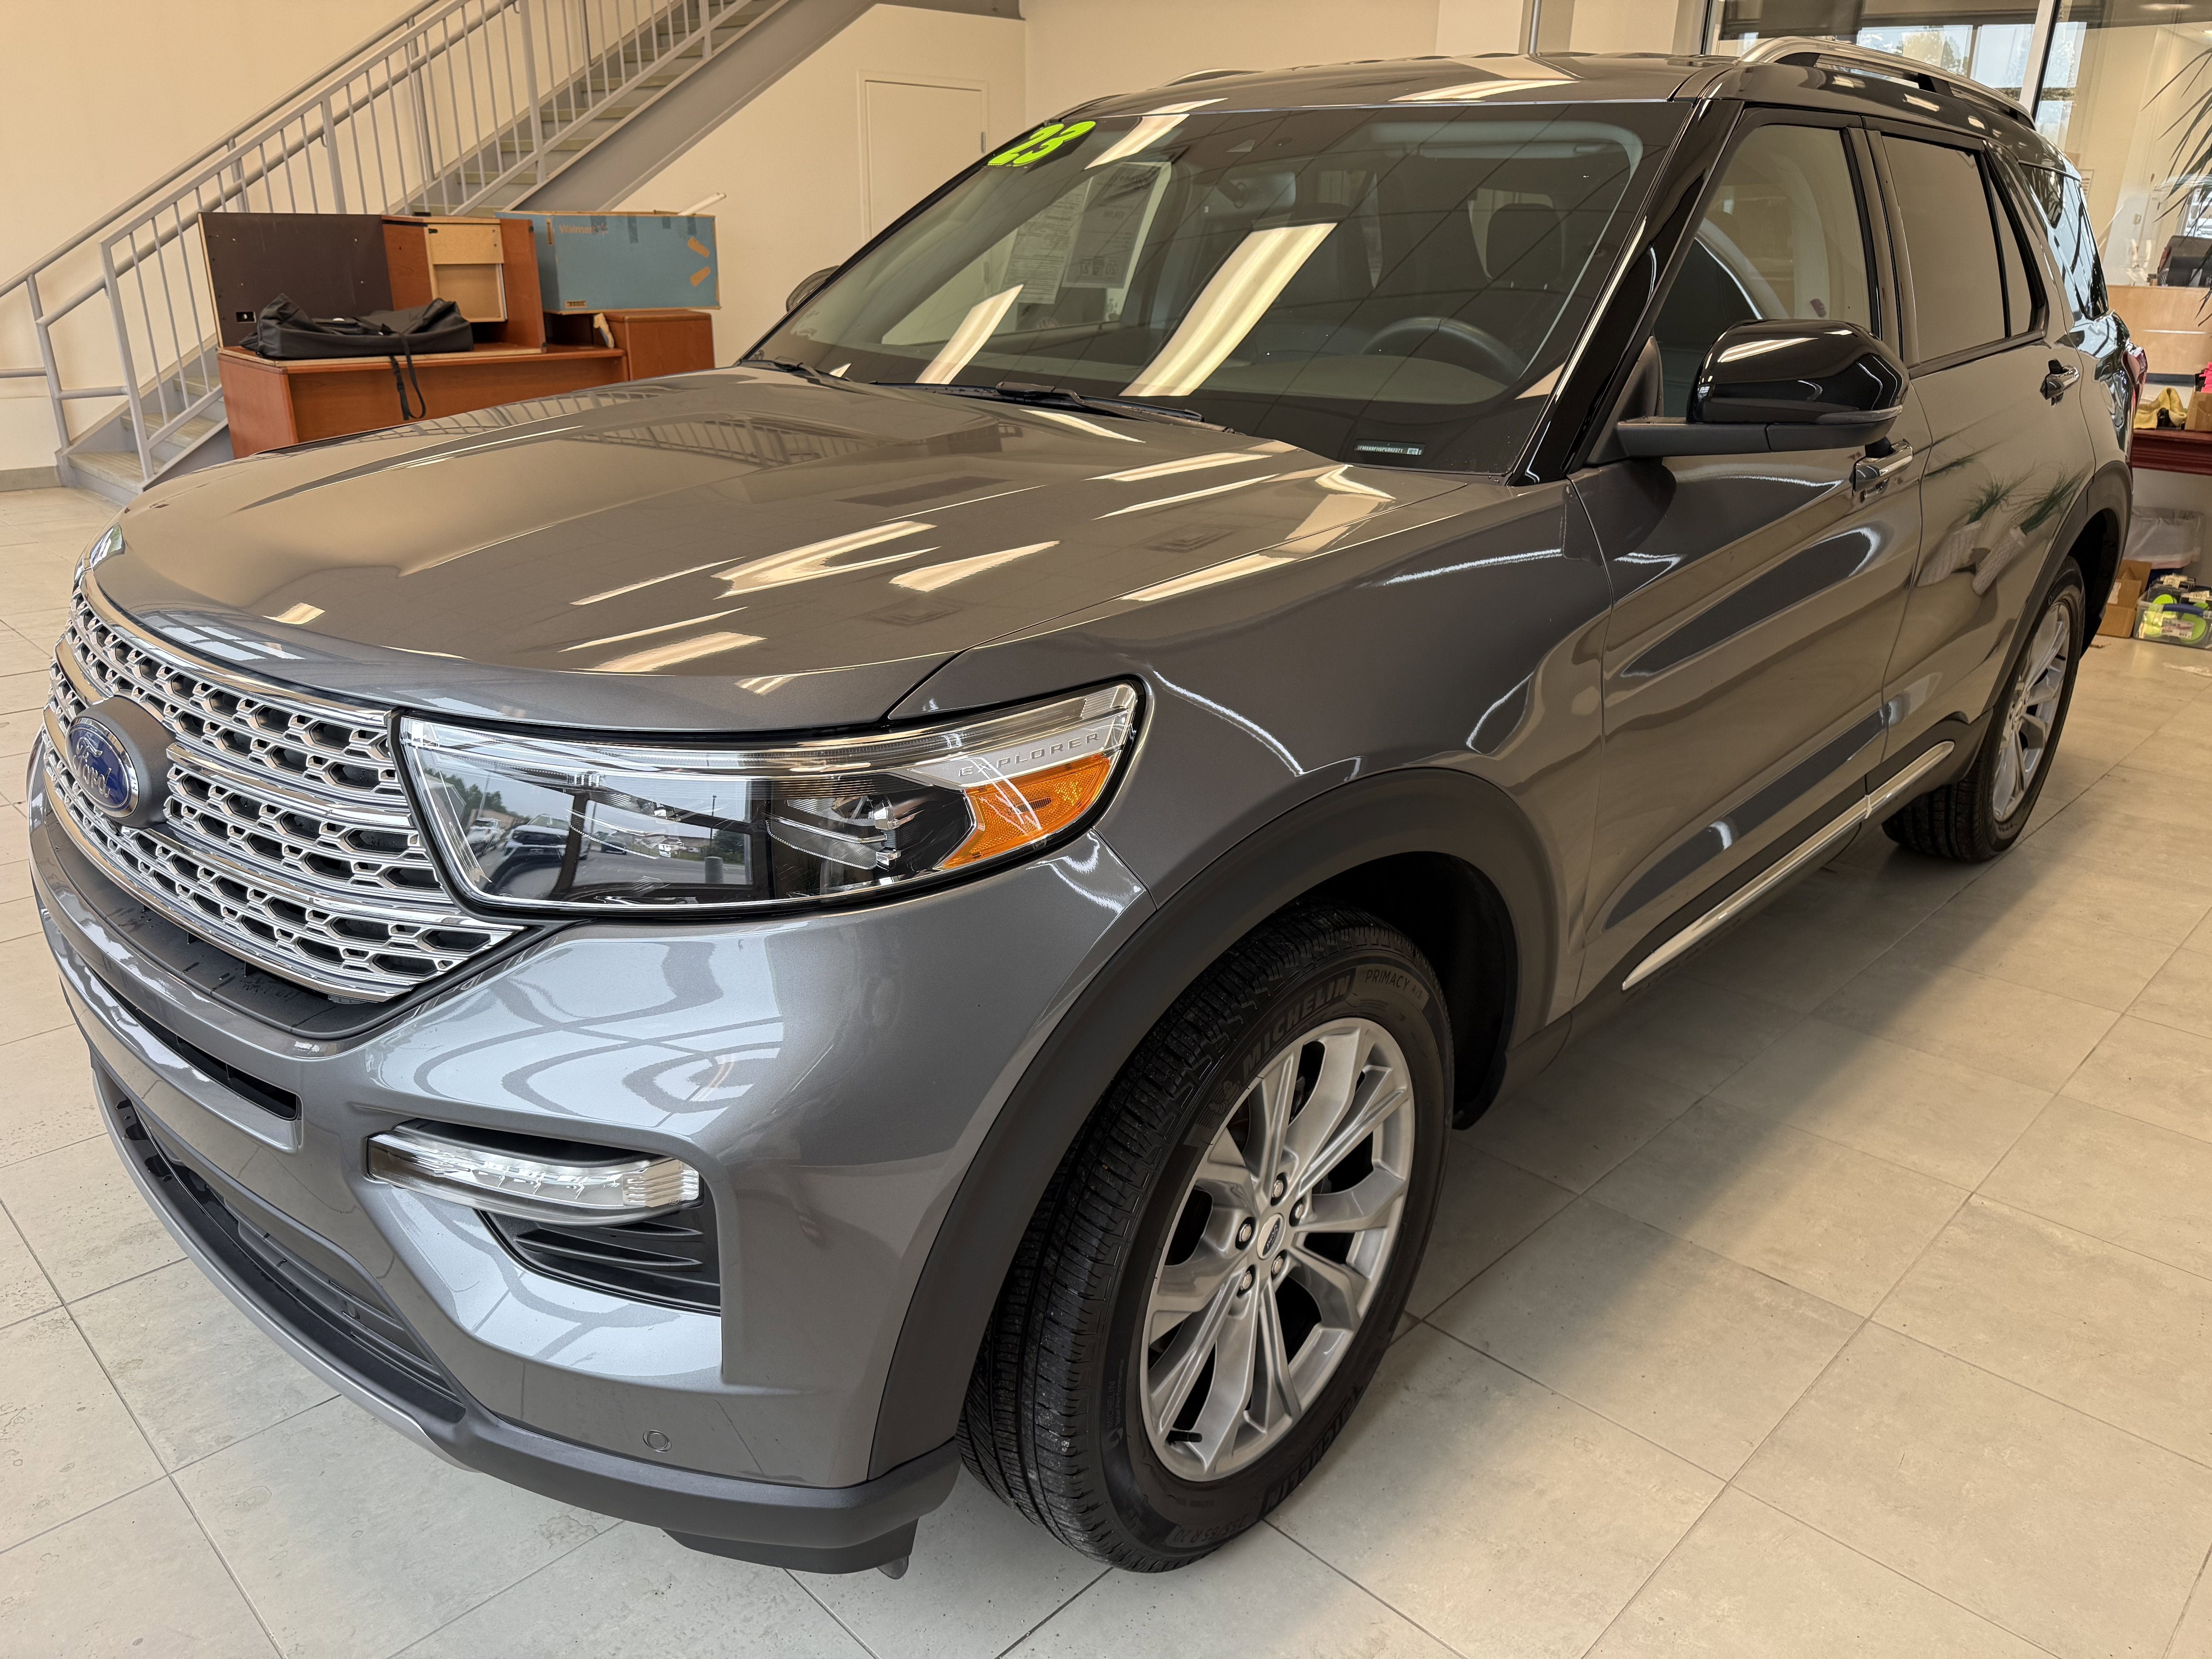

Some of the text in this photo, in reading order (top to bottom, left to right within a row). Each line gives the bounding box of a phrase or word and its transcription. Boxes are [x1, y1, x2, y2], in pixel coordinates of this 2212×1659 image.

[988, 121, 1096, 166] 23
[559, 225, 597, 234] Walmart
[72, 736, 112, 798] Ford
[958, 732, 1099, 777] EXPLORER
[1364, 969, 1423, 999] PRIMACY A/S
[1242, 974, 1350, 1080] MICHELIN
[1107, 1381, 1116, 1428] MICHELIN
